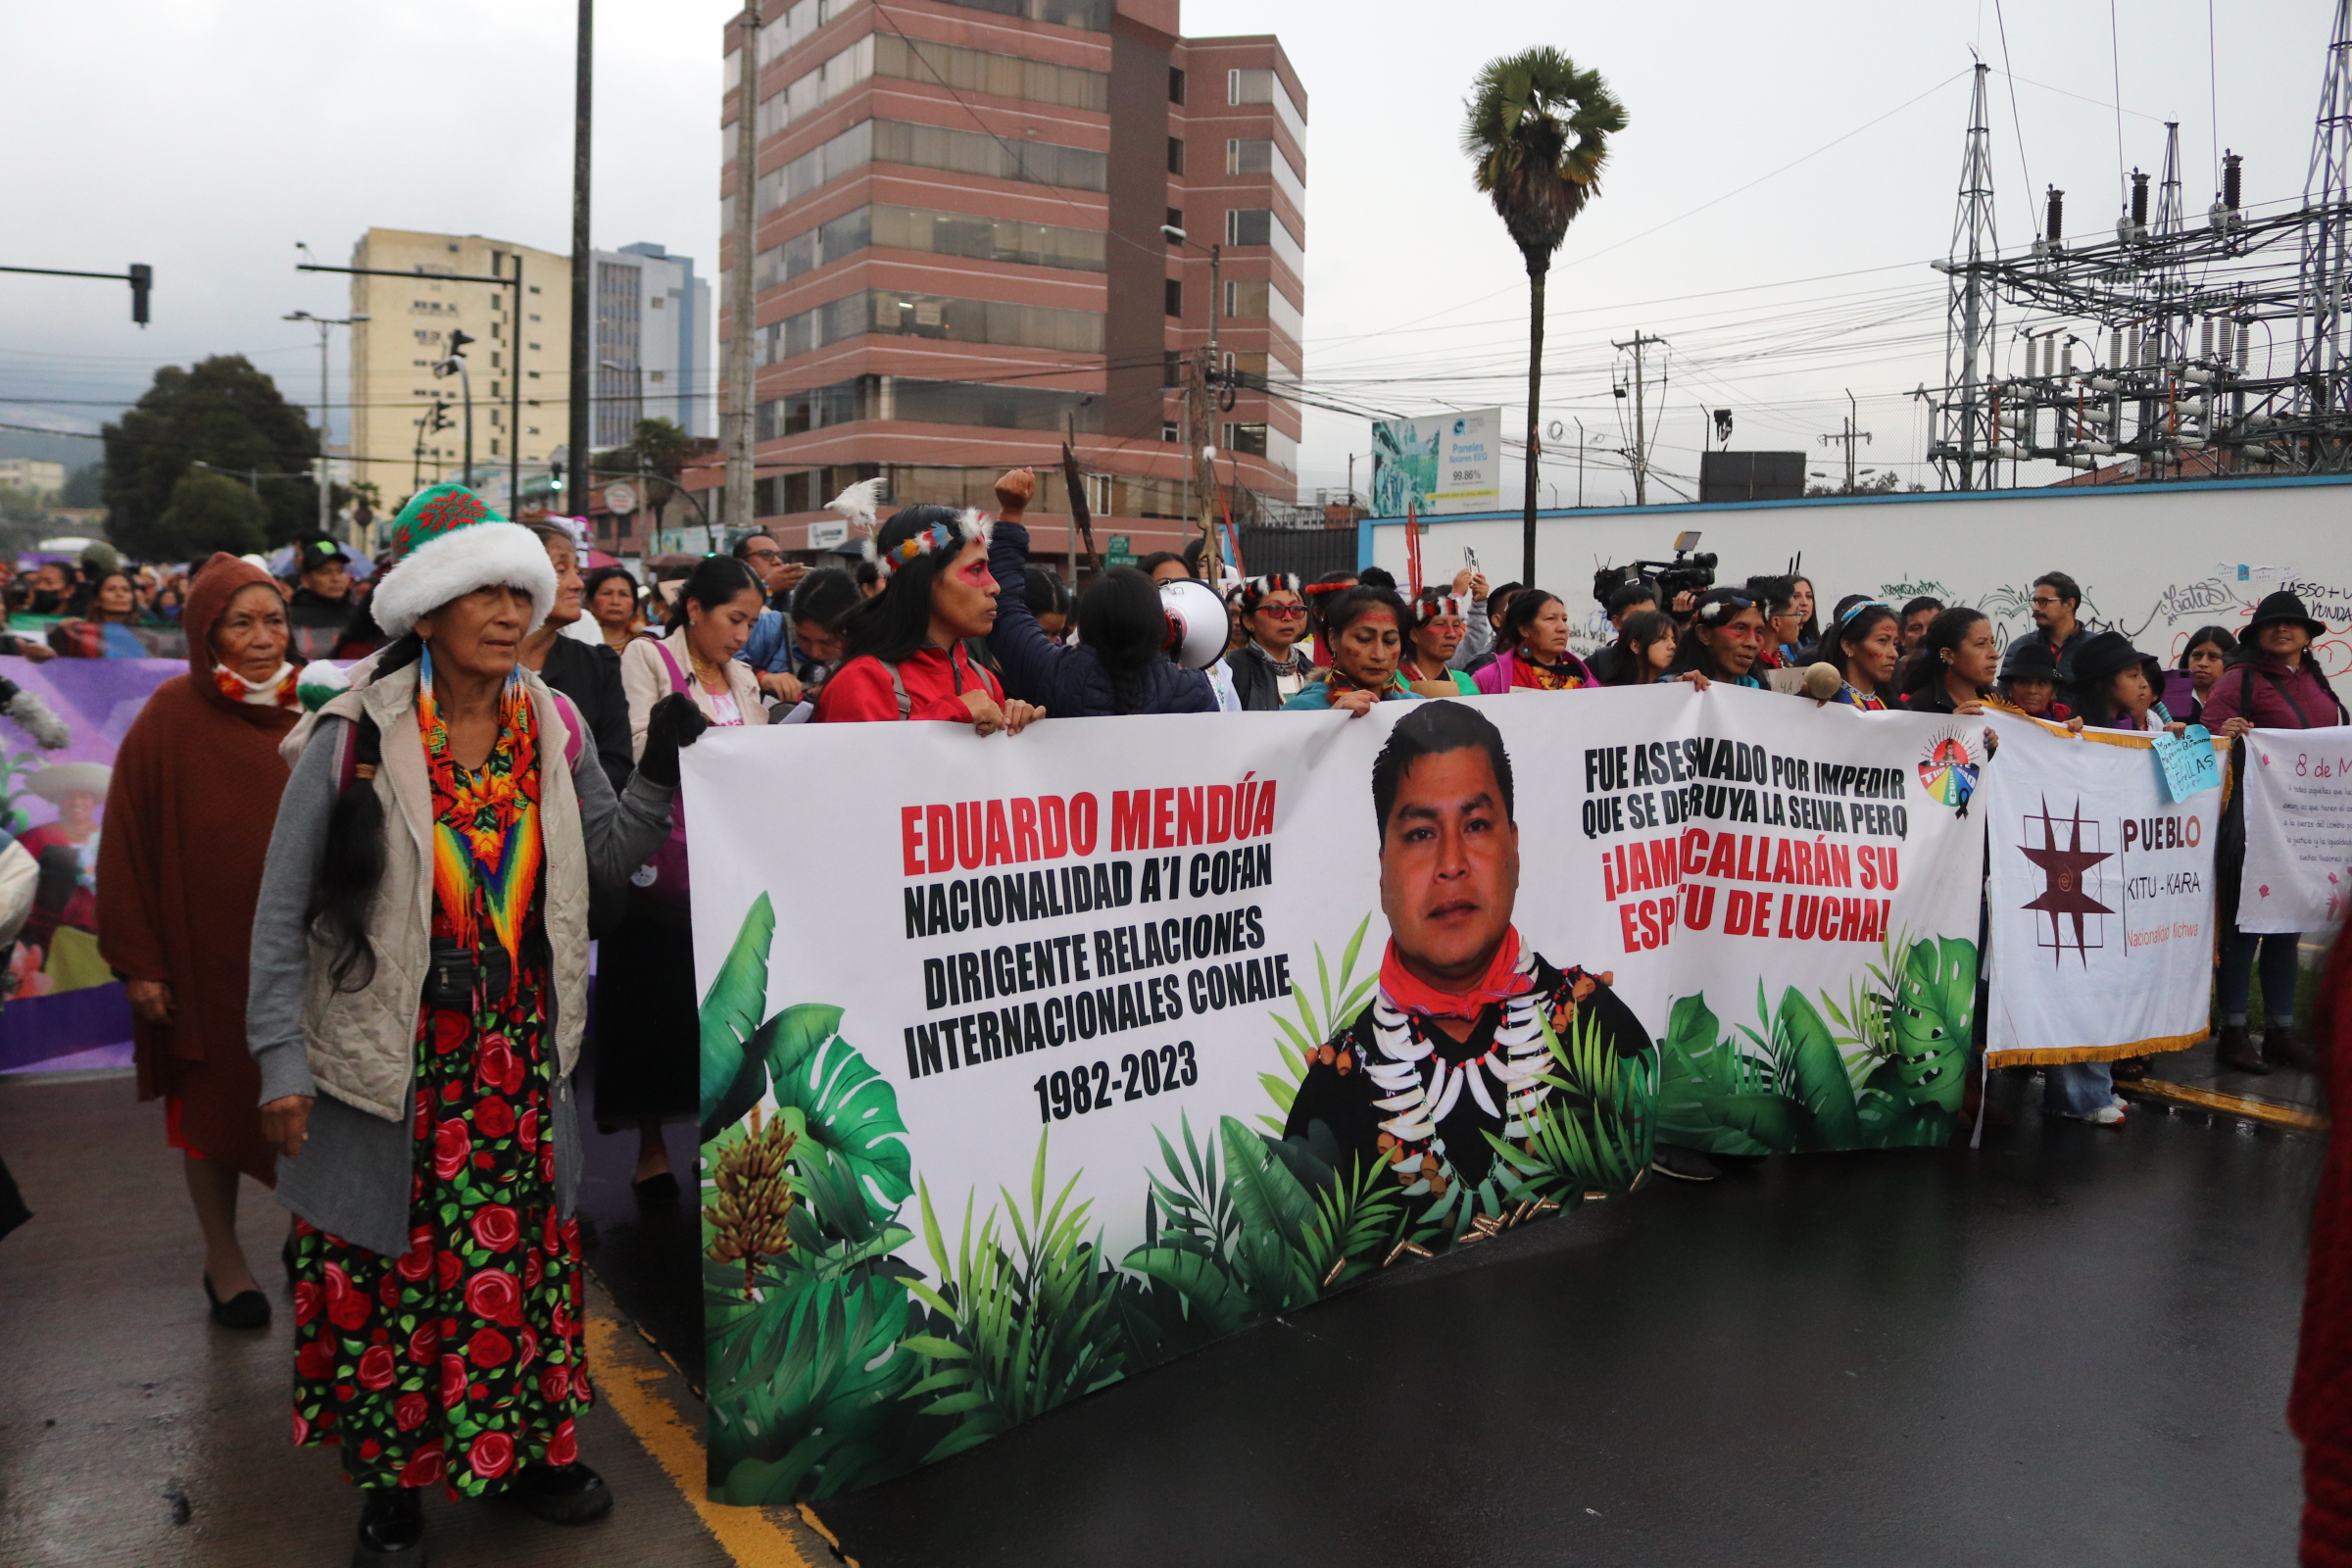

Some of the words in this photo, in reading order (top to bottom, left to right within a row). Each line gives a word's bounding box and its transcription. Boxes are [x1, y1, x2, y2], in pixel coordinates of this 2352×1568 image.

[1452, 442, 1484, 454] Paneles
[1452, 469, 1481, 481] 99.86%
[1585, 748, 1628, 793] FUE
[1772, 755, 1809, 792] POR
[1815, 762, 1905, 800] IMPEDIR
[2295, 753, 2308, 777] 8
[2314, 757, 2332, 778] de
[1582, 795, 1624, 840] QUE
[1627, 792, 1659, 830] SE
[1763, 791, 1786, 826] LA
[1788, 796, 1847, 833] SELVA
[2308, 787, 2331, 797] aquellas
[2332, 789, 2342, 798] que
[2309, 805, 2319, 813] que
[901, 792, 1098, 876] EDUARDO
[1111, 770, 1276, 853] MENDÚA
[2123, 814, 2201, 853] PUEBLO
[2293, 837, 2312, 847] justicia
[2327, 820, 2345, 829] cambio
[1682, 828, 1850, 888] CALLARÁN
[1857, 845, 1898, 891] SU
[904, 860, 1132, 940] NACIONALIDAD
[1189, 843, 1272, 898] COFAN
[1723, 890, 1771, 938] DE
[1778, 894, 1890, 943] LUCHA!
[923, 934, 1090, 1011] DIRIGENTE
[1094, 905, 1265, 978] RELACIONES
[904, 973, 1183, 1080] INTERNACIONALES
[1188, 953, 1293, 1015] CONAIE
[1033, 1040, 1198, 1124] 1982-2023
